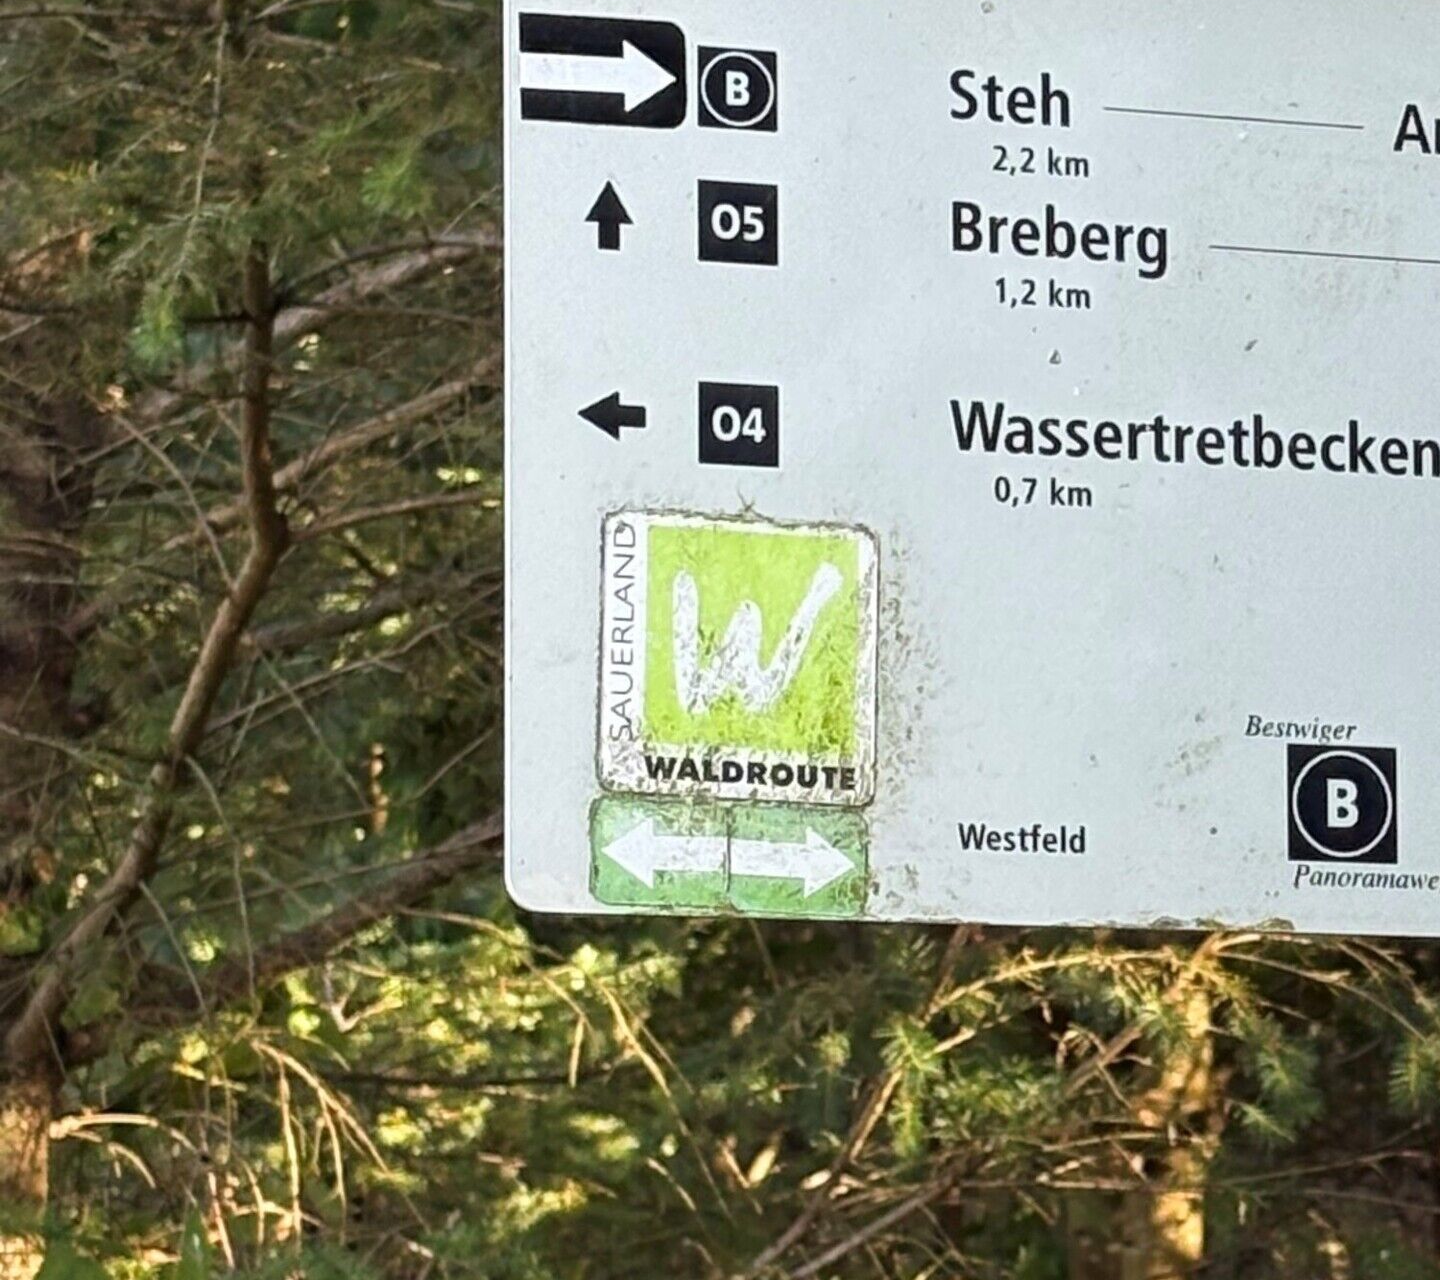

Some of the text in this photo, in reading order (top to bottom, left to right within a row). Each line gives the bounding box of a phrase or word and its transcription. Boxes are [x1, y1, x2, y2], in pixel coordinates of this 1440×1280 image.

[725, 70, 750, 106] B
[949, 69, 1070, 127] Steh
[992, 145, 1090, 178] 2,2 km
[951, 200, 1168, 280] Breberg
[995, 277, 1091, 310] 1,2 km
[994, 475, 1093, 508] 0,7 km
[609, 521, 637, 742] SAUERLAND
[1244, 714, 1358, 742] Bestwiger
[643, 754, 857, 791] WALDROUTE
[1326, 778, 1360, 828] B
[957, 822, 1087, 854] Westfeld
